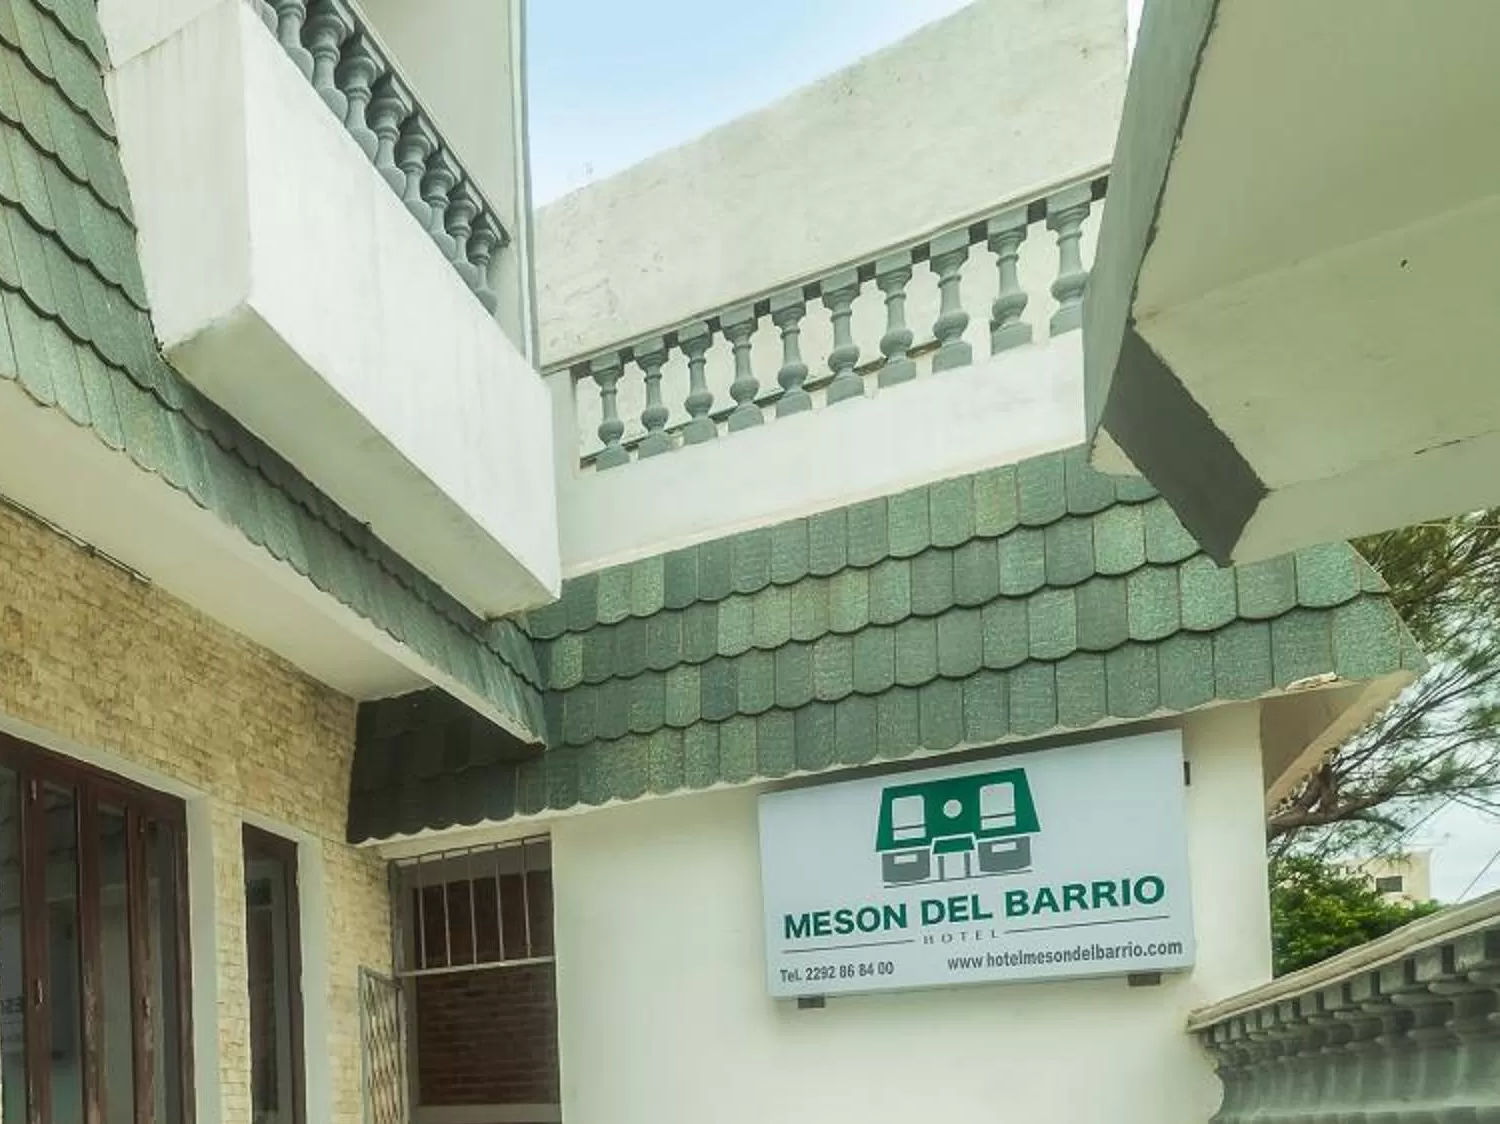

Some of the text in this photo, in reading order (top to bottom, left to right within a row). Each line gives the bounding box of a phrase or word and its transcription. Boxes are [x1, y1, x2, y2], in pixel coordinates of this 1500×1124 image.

[784, 875, 1165, 939] MESON DEL BARRIO
[923, 929, 999, 945] HOTEL
[805, 965, 836, 981] 2292
[839, 963, 855, 978] 86
[858, 962, 874, 976] 84
[877, 961, 894, 975] 00
